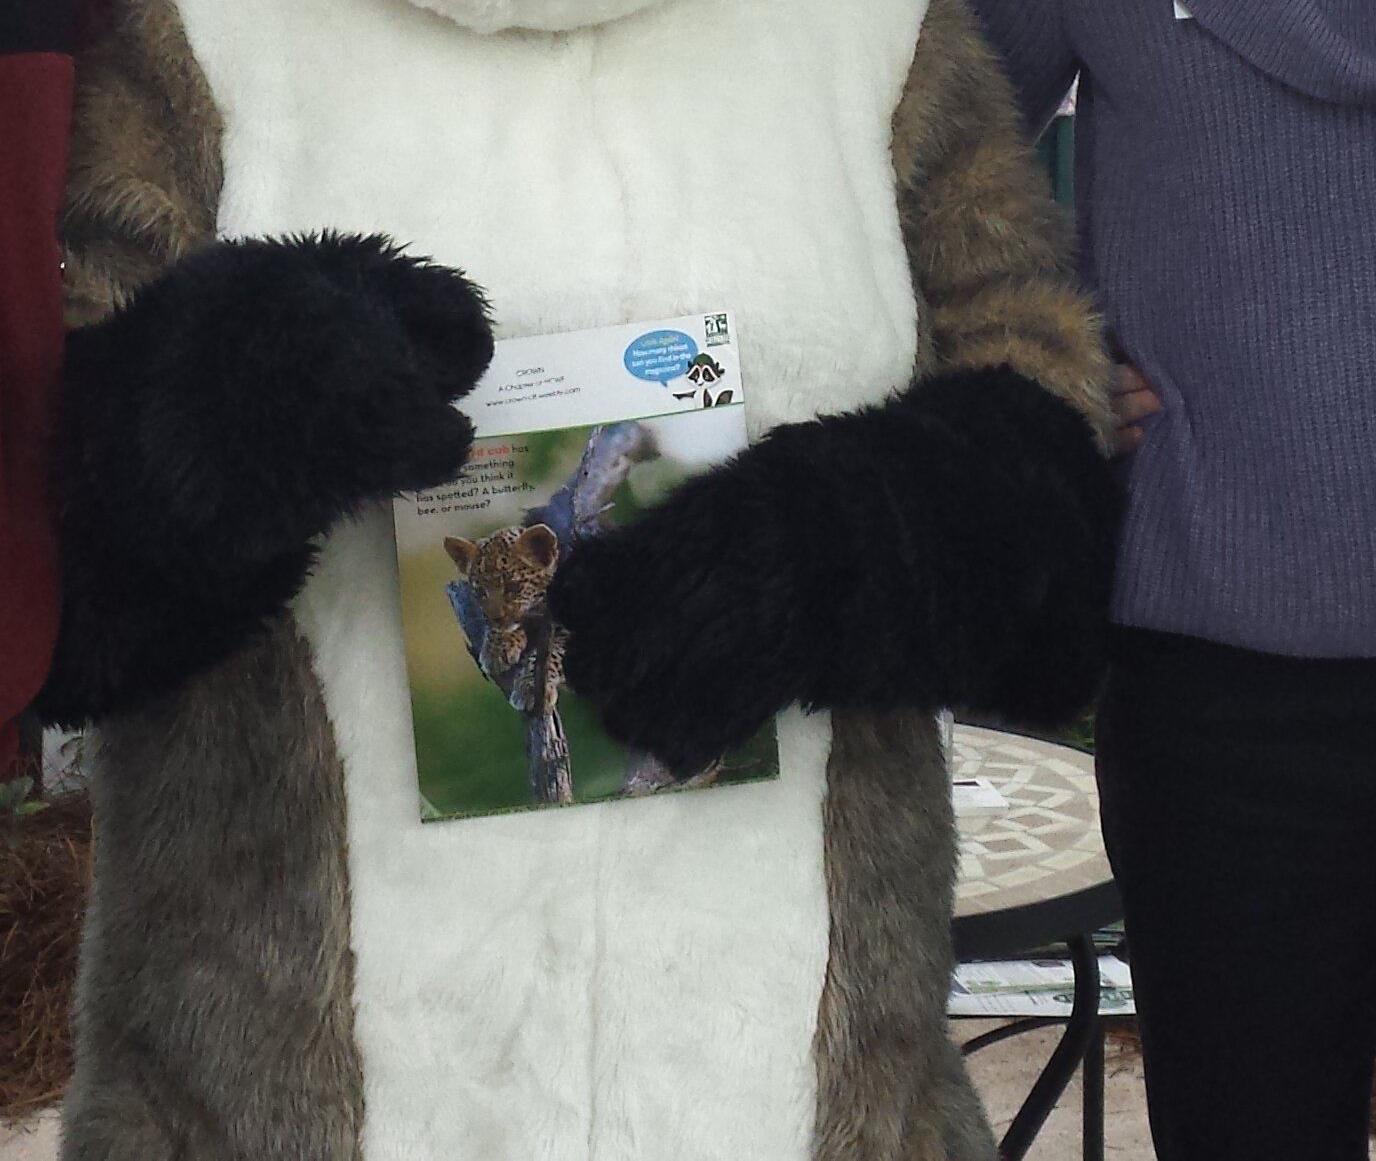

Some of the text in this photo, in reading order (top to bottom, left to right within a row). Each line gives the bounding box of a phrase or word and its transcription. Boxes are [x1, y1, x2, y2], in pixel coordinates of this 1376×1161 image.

[511, 443, 529, 453] has
[464, 458, 514, 471] something
[460, 476, 478, 487] you
[480, 472, 505, 483] think
[416, 493, 434, 503] has
[436, 487, 479, 502] spotted?
[441, 504, 452, 513] or
[454, 499, 491, 512] mouse?
